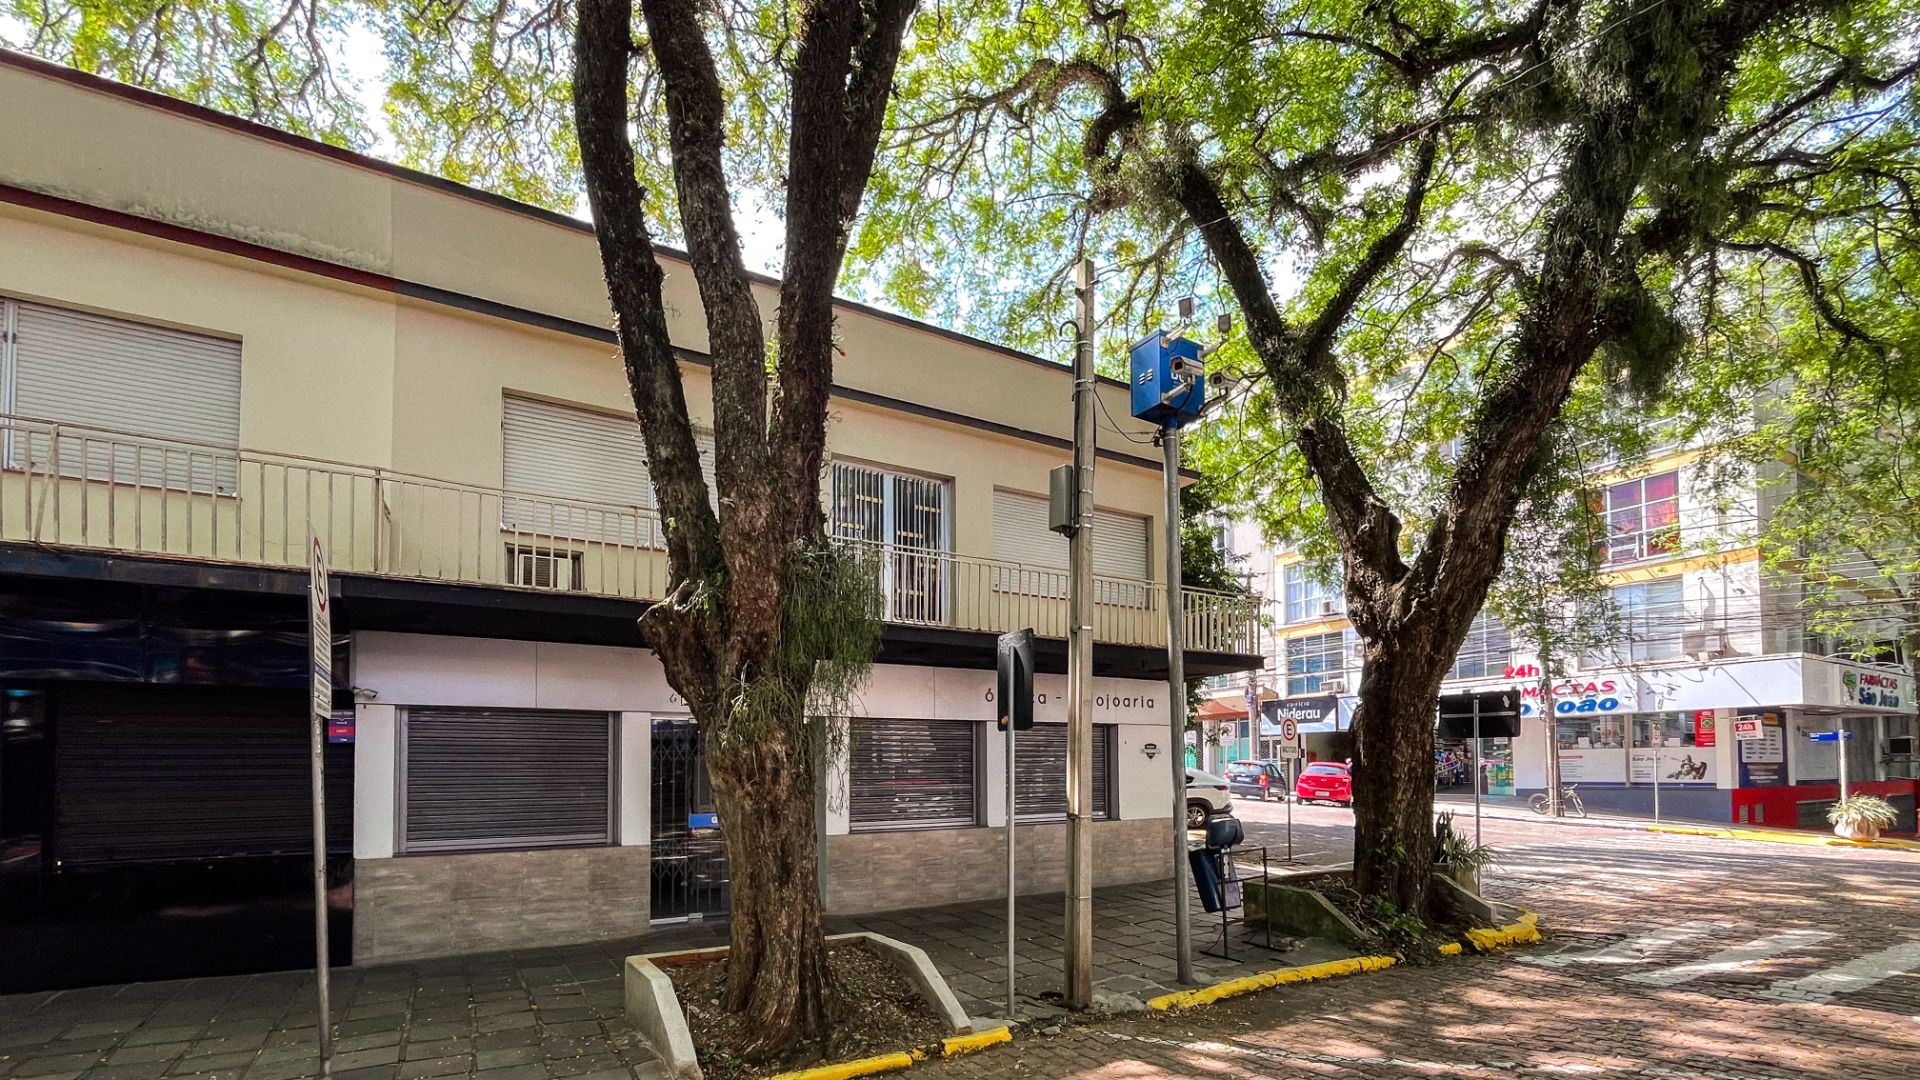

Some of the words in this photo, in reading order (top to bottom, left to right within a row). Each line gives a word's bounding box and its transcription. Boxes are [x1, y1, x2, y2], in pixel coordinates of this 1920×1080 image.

[1503, 664, 1540, 679] 24h
[1096, 694, 1155, 710] ojoaria
[1556, 694, 1619, 713] oão
[1277, 707, 1321, 721] Niderau
[1286, 723, 1293, 736] E
[1737, 723, 1754, 731] 24h
